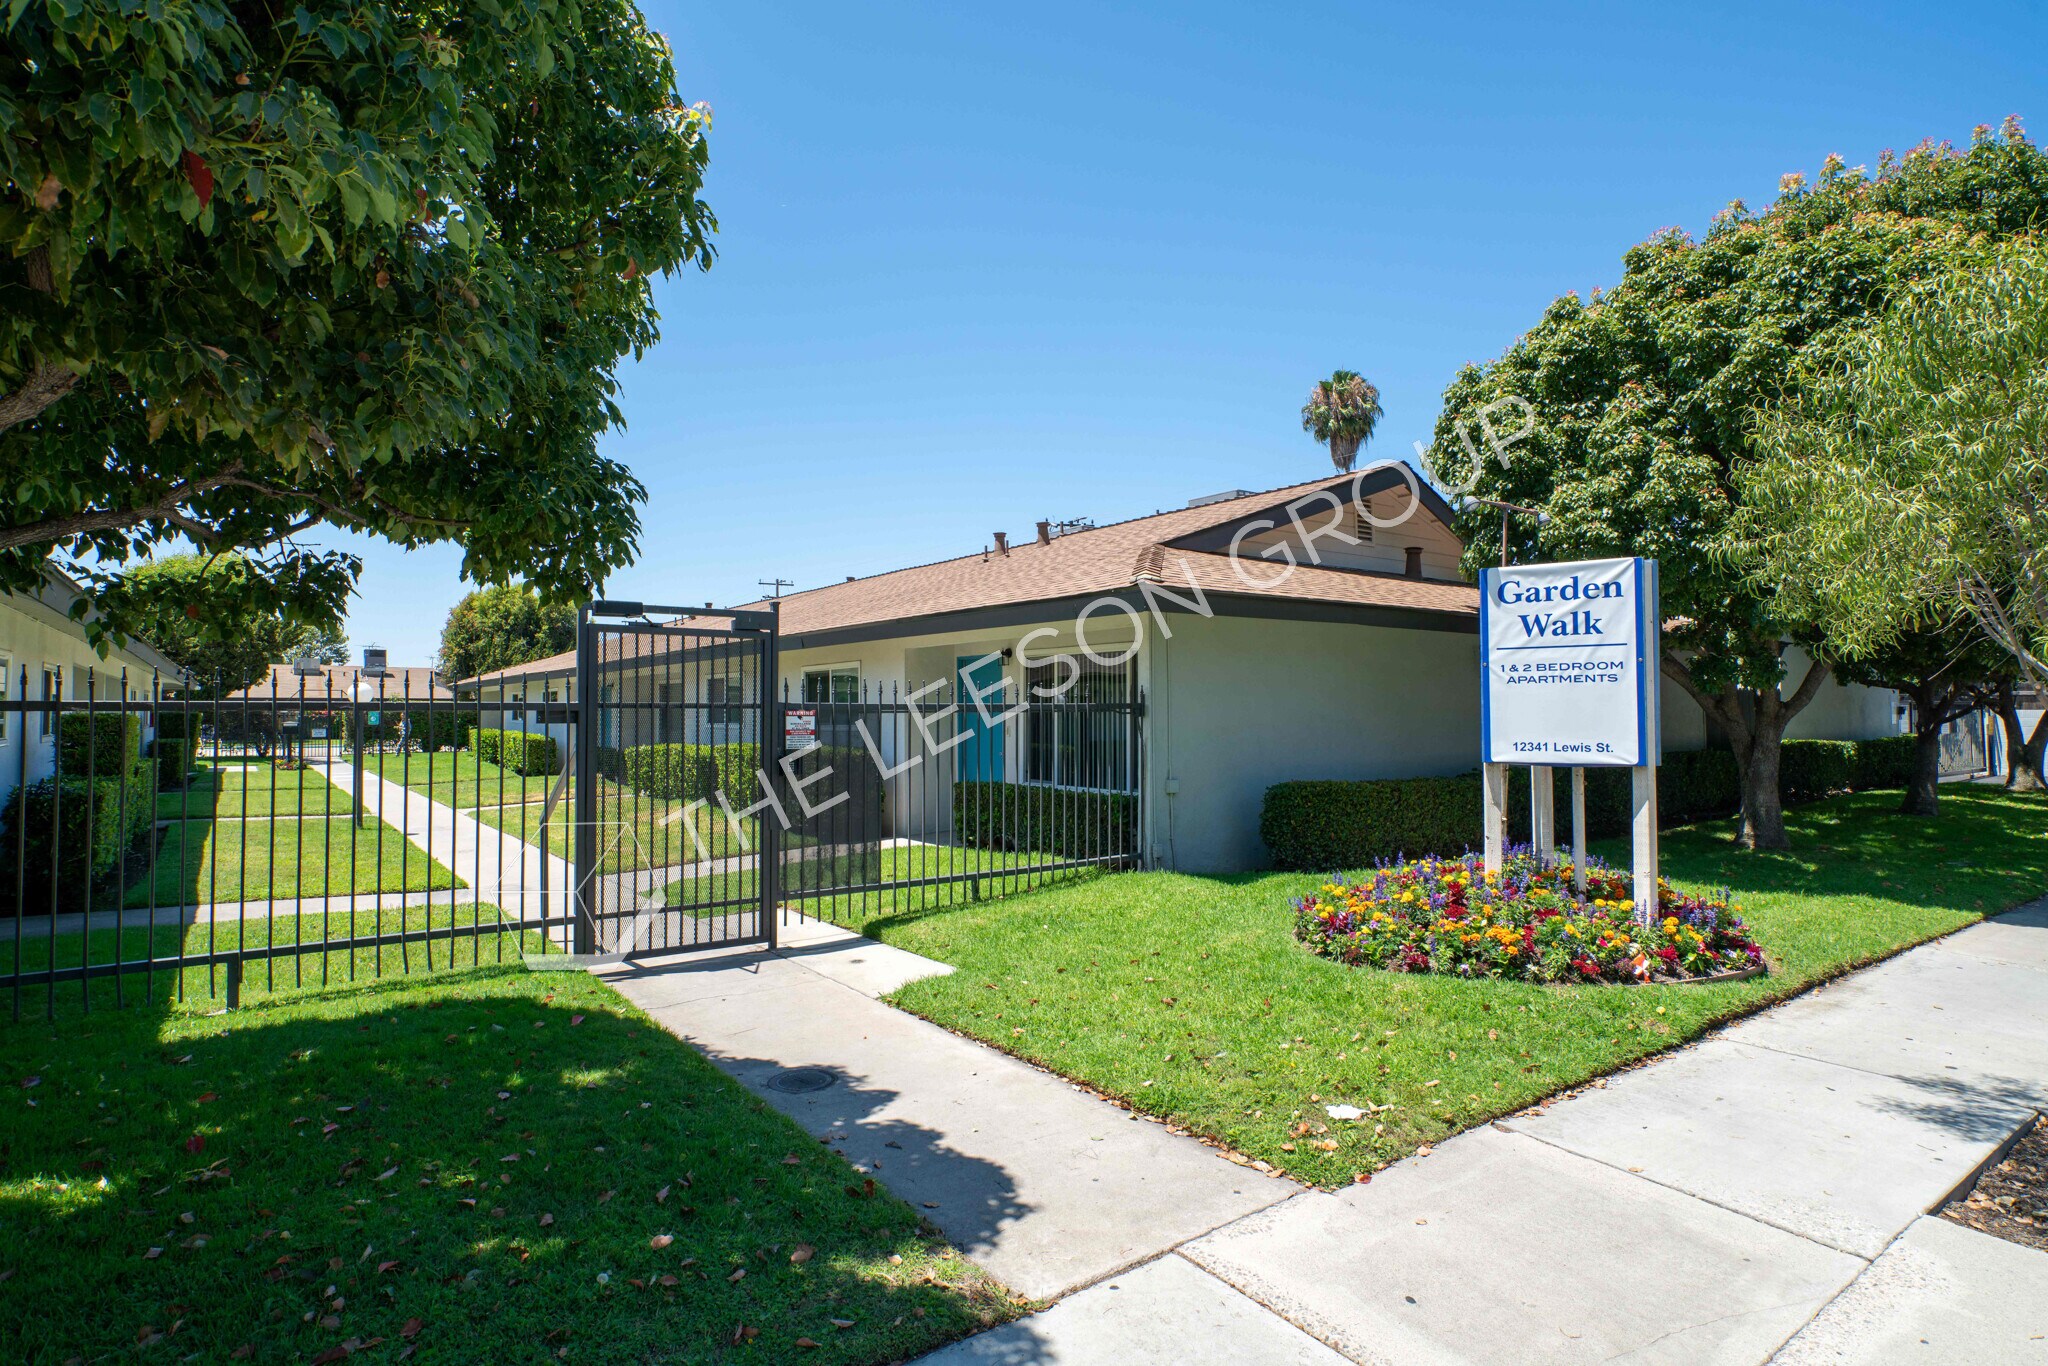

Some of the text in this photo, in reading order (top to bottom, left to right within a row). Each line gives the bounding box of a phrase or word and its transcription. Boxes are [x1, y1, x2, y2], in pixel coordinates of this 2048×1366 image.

[1497, 576, 1624, 605] Garden
[1518, 610, 1604, 637] Walk
[1500, 661, 1624, 673] 1 & 2 BEDROOM
[1507, 674, 1618, 684] APARTMENTS
[1512, 742, 1614, 753] 12341 Lewis St.
